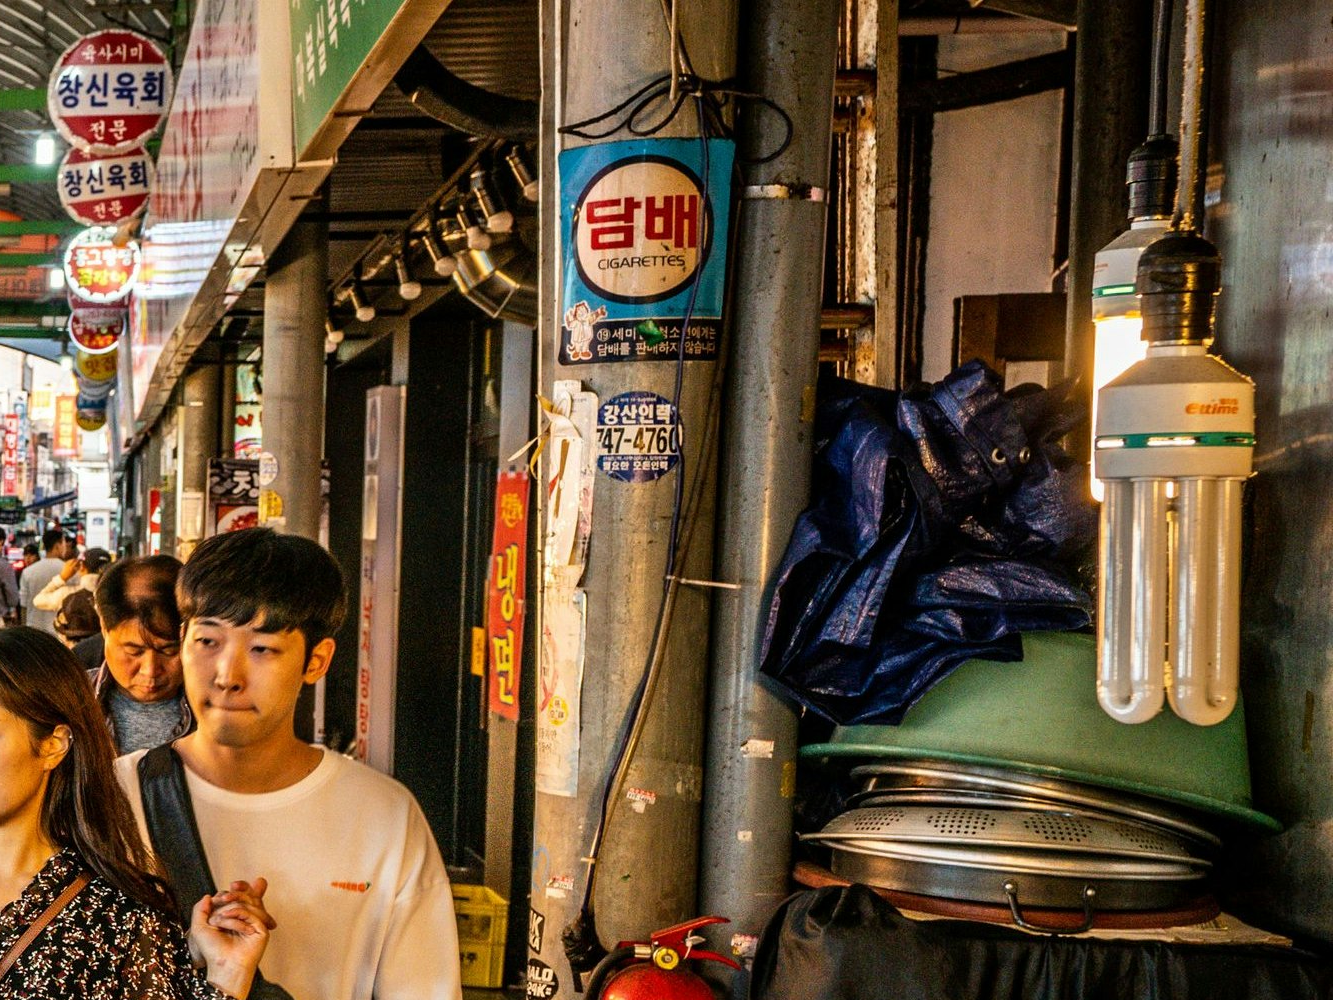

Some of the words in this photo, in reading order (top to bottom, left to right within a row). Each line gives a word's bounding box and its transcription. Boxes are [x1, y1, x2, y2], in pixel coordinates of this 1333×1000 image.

[82, 43, 144, 62] 육사시미
[58, 71, 165, 109] 창신육회
[89, 119, 127, 141] 전문
[64, 160, 149, 198] 창신육회
[93, 200, 123, 219] 전문
[586, 195, 697, 252] 담배
[597, 253, 686, 271] CIGARETTES
[603, 404, 671, 425] 강산인력
[492, 543, 519, 706] 냉면
